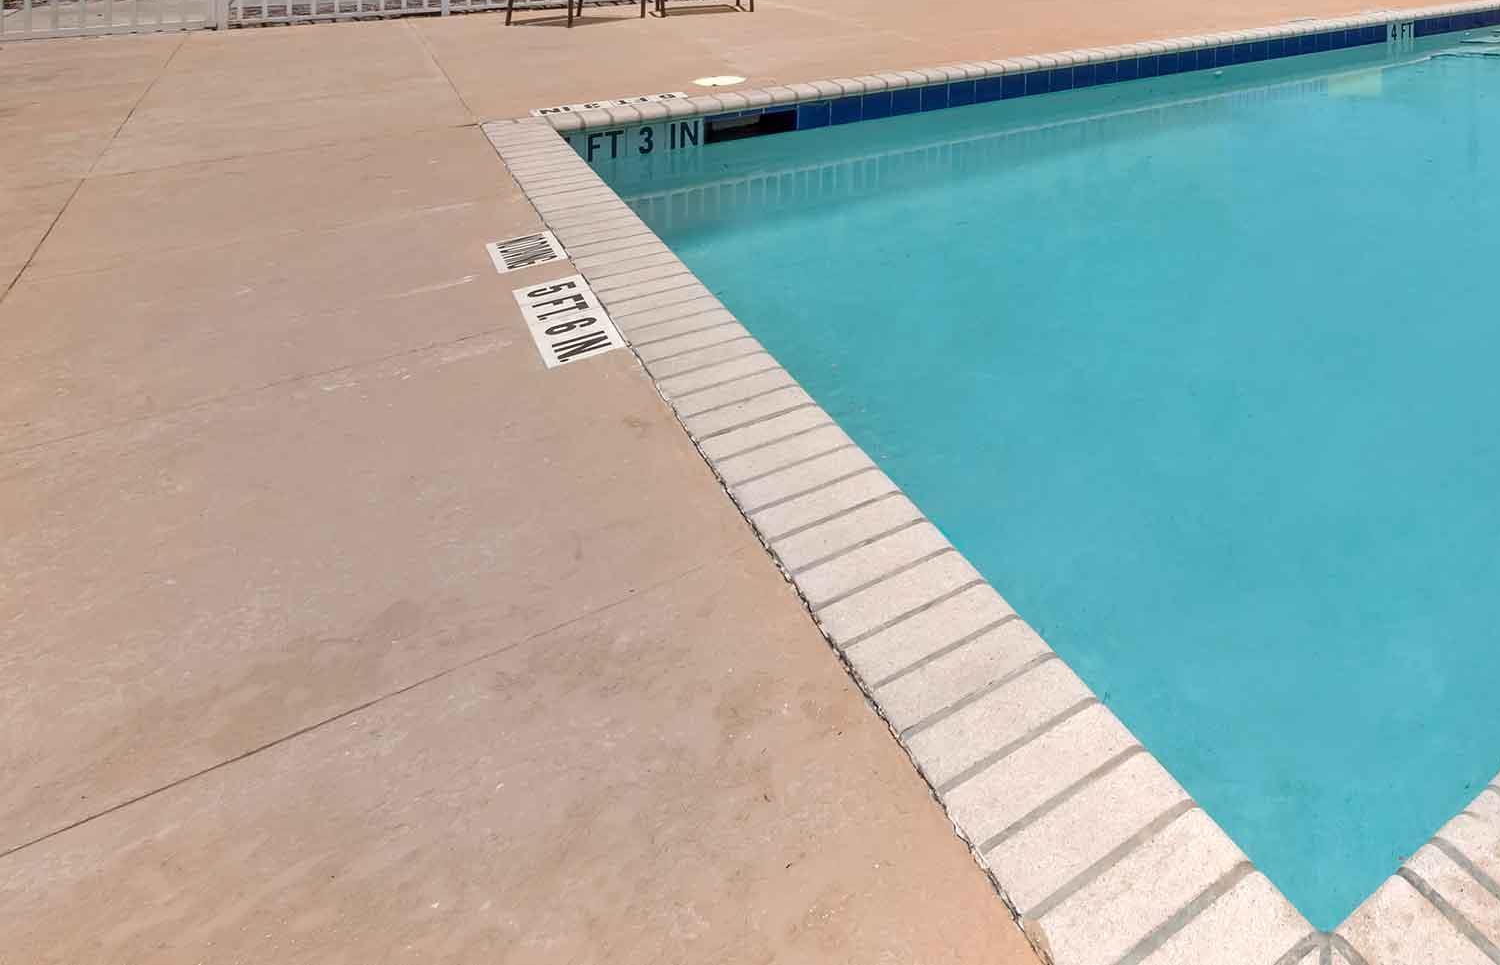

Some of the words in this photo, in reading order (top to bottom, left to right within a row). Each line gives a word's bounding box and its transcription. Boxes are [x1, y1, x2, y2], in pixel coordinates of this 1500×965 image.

[1401, 22, 1414, 39] FT
[586, 129, 624, 163] FT
[638, 126, 654, 155] 3
[670, 119, 699, 150] IN
[526, 280, 577, 298] 5
[544, 316, 597, 336] 6
[551, 330, 612, 363] IN.
